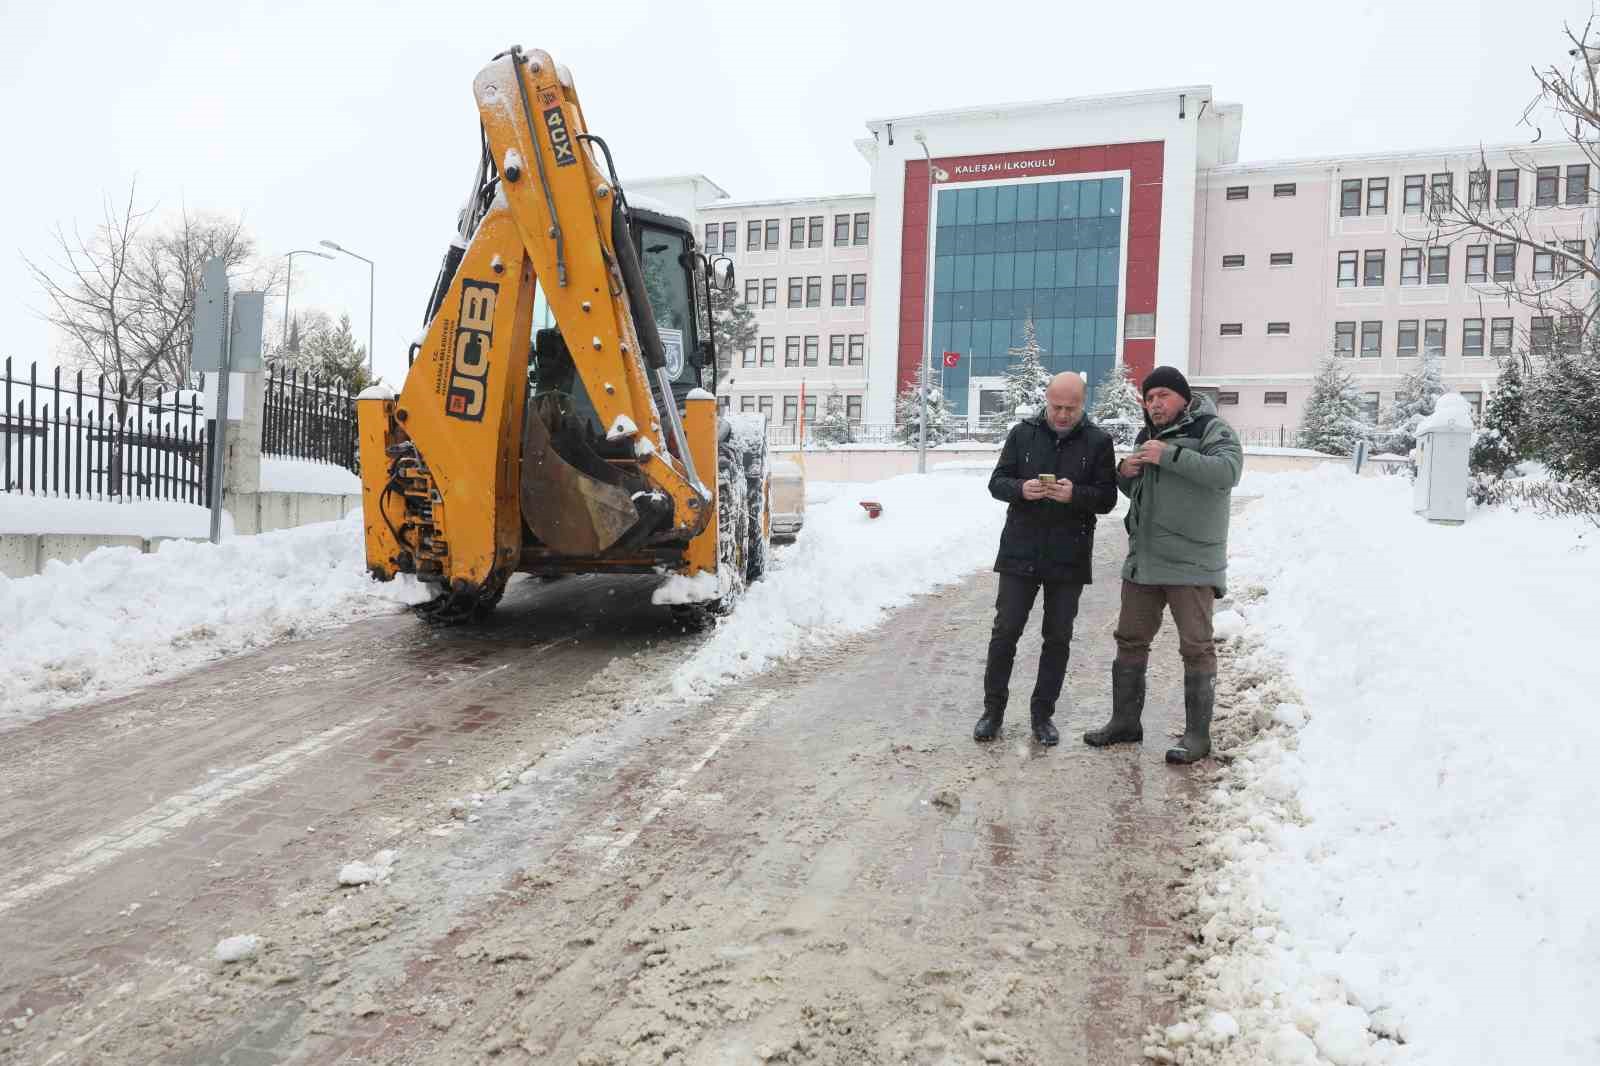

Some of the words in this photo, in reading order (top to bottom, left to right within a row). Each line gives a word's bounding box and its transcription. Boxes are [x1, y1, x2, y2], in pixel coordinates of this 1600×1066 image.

[547, 112, 572, 161] 4CX
[955, 163, 1001, 175] KALEŞAH
[1004, 158, 1056, 170] İLKOKULU
[453, 285, 497, 416] JCB
